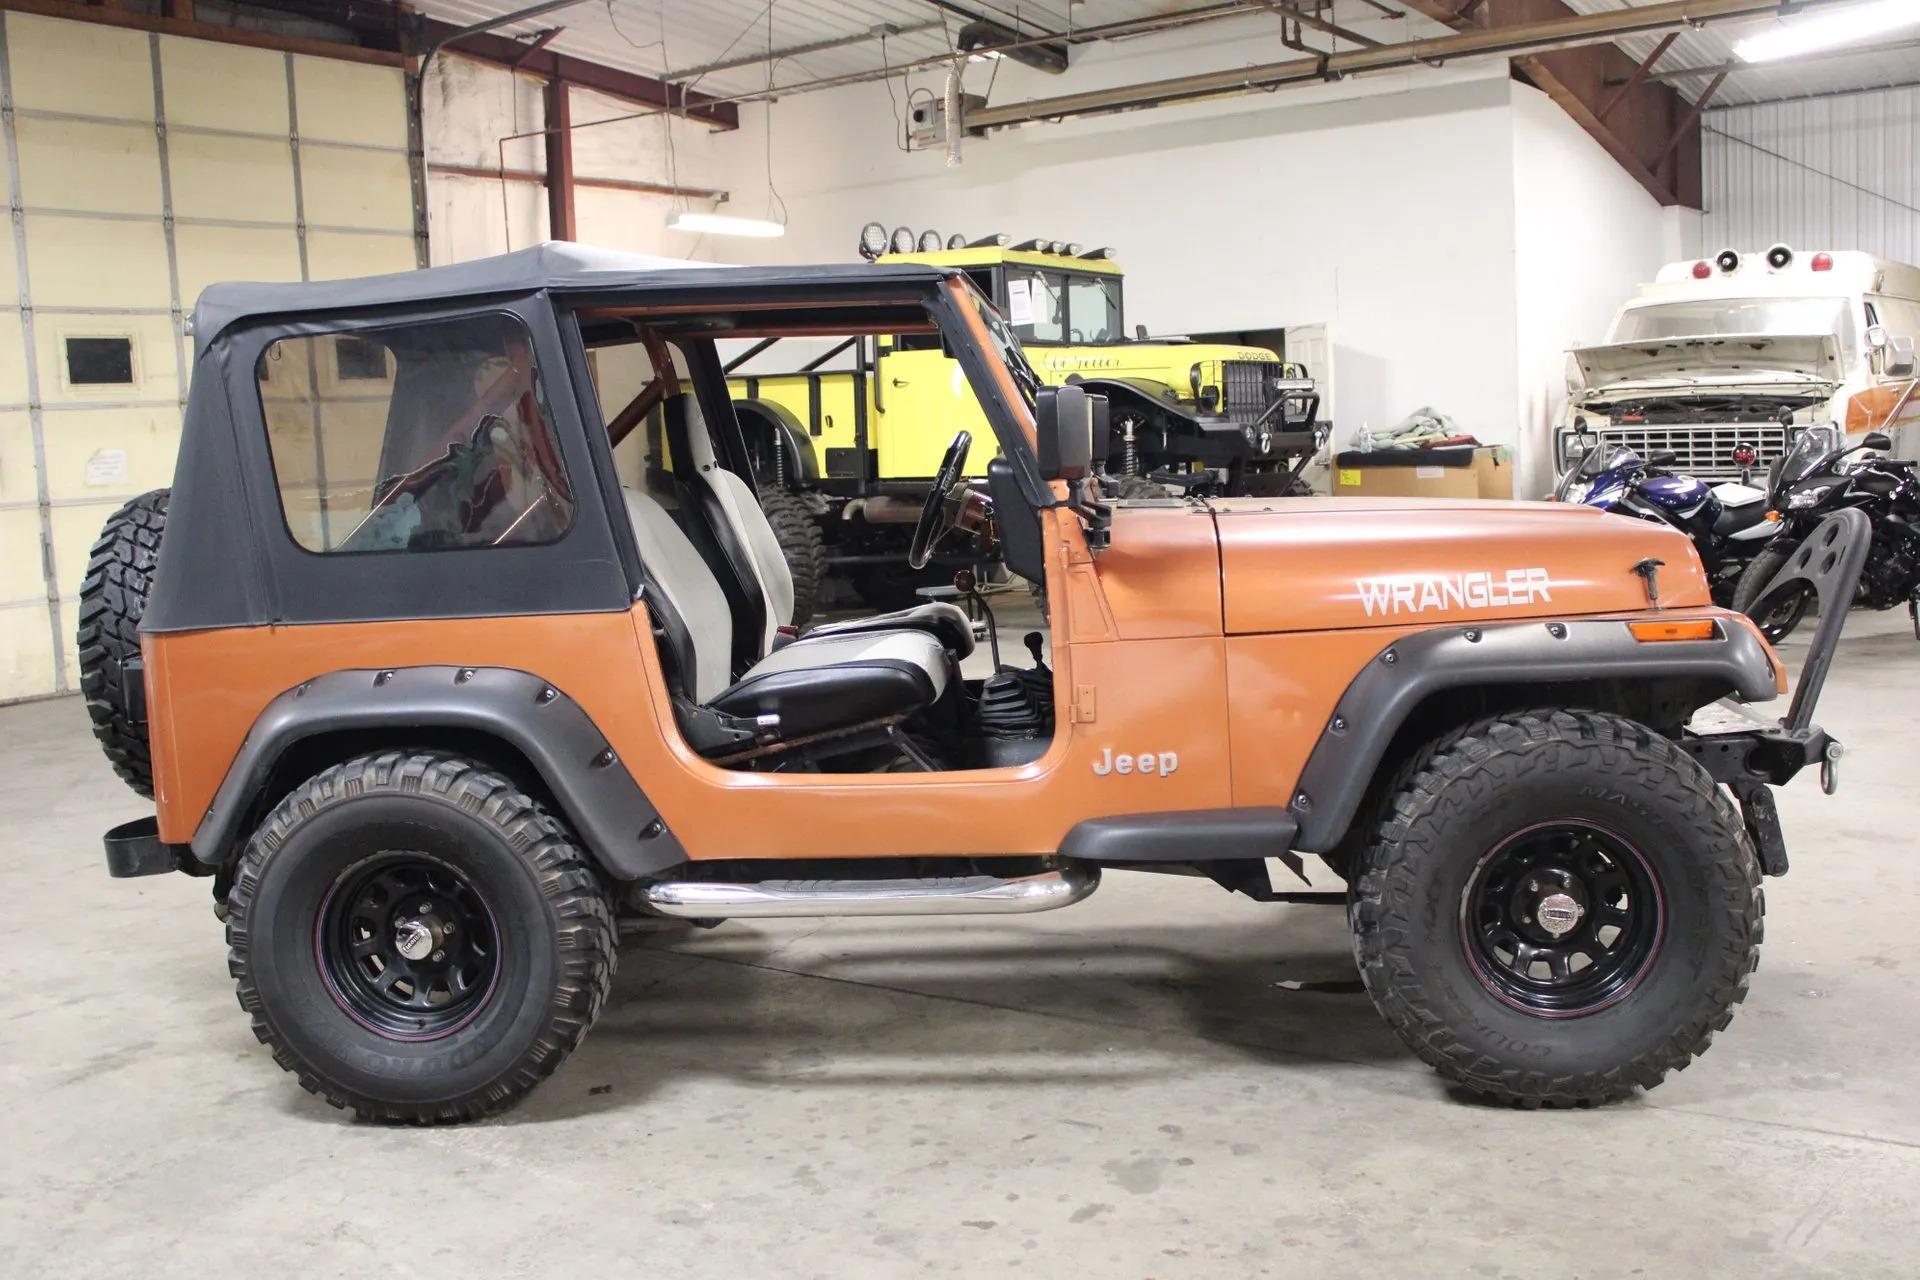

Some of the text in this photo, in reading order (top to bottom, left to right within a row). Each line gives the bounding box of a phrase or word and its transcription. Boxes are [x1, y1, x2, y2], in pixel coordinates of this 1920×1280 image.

[1237, 351, 1272, 361] DODGE
[1355, 567, 1553, 617] WRANGLER
[1092, 747, 1178, 777] Jeep
